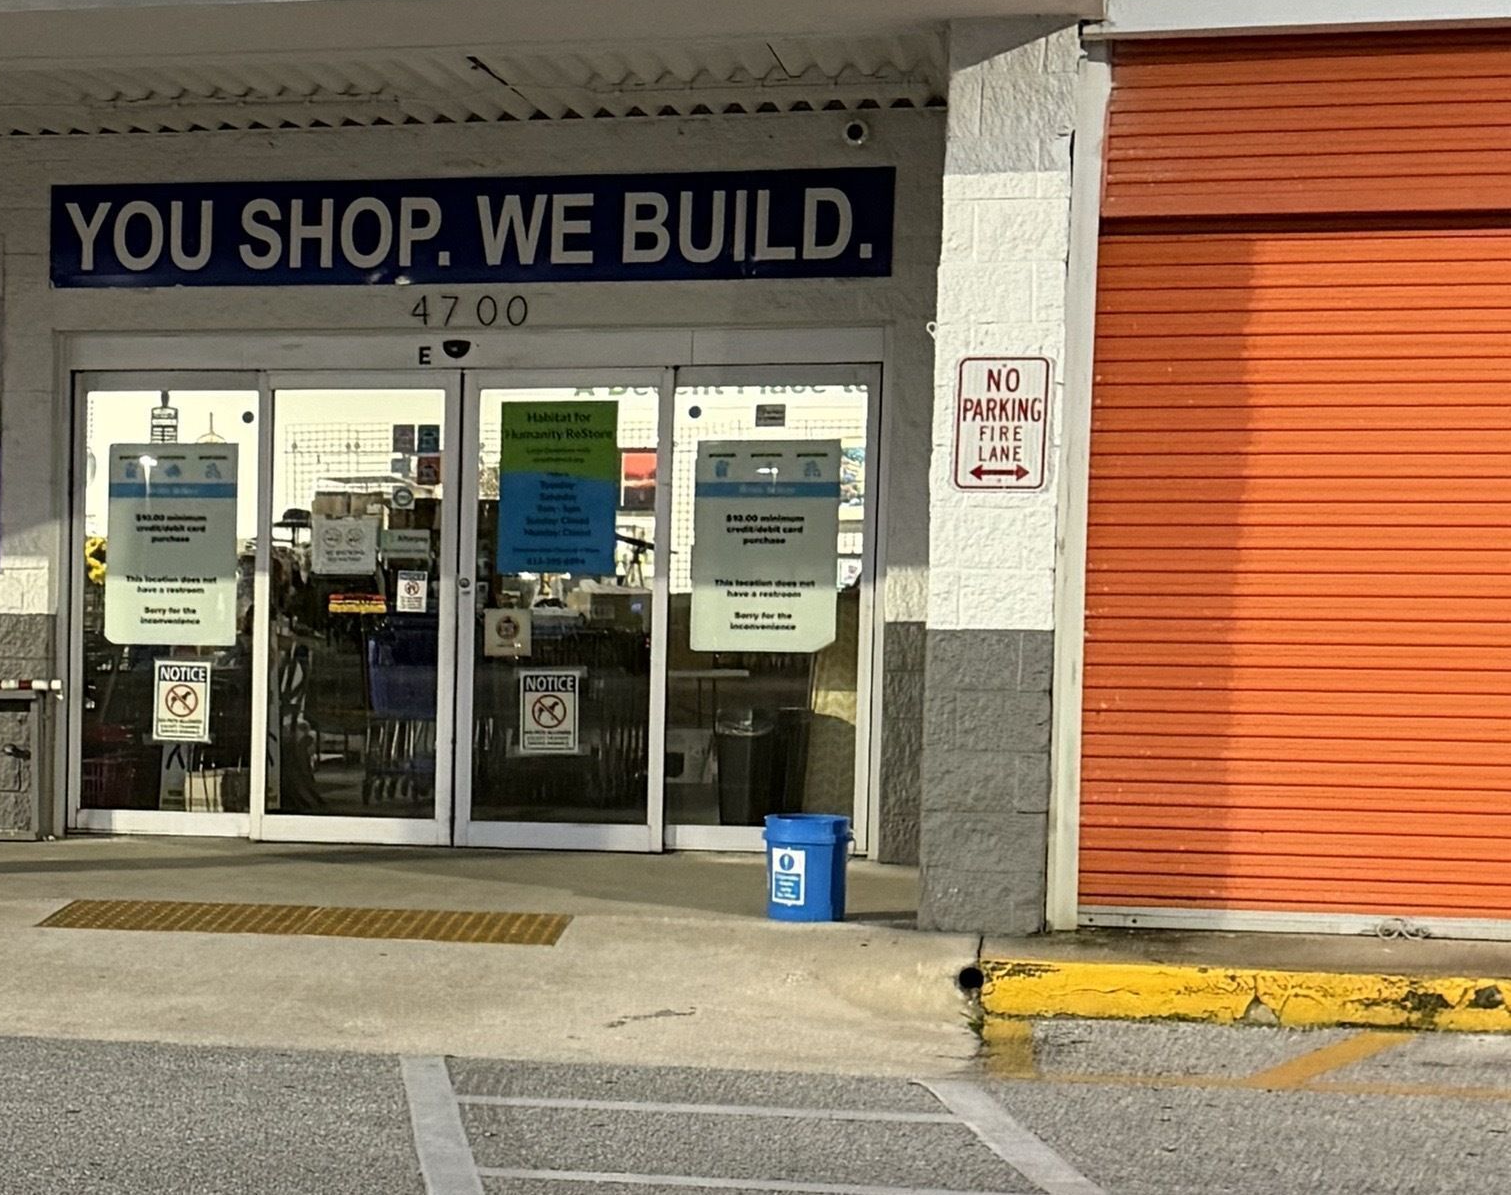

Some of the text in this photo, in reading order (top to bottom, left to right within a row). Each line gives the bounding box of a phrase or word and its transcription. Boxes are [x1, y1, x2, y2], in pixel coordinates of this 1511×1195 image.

[65, 187, 873, 273] YOU SHOP. WE BUILD.
[411, 294, 529, 327] 4700
[418, 346, 432, 365] E
[986, 367, 1021, 393] NO
[962, 397, 1043, 423] PARKING
[979, 425, 1023, 442] FIRE
[978, 445, 1023, 463] LANE
[159, 666, 207, 682] NOTICE
[525, 676, 575, 692] NOTICE
